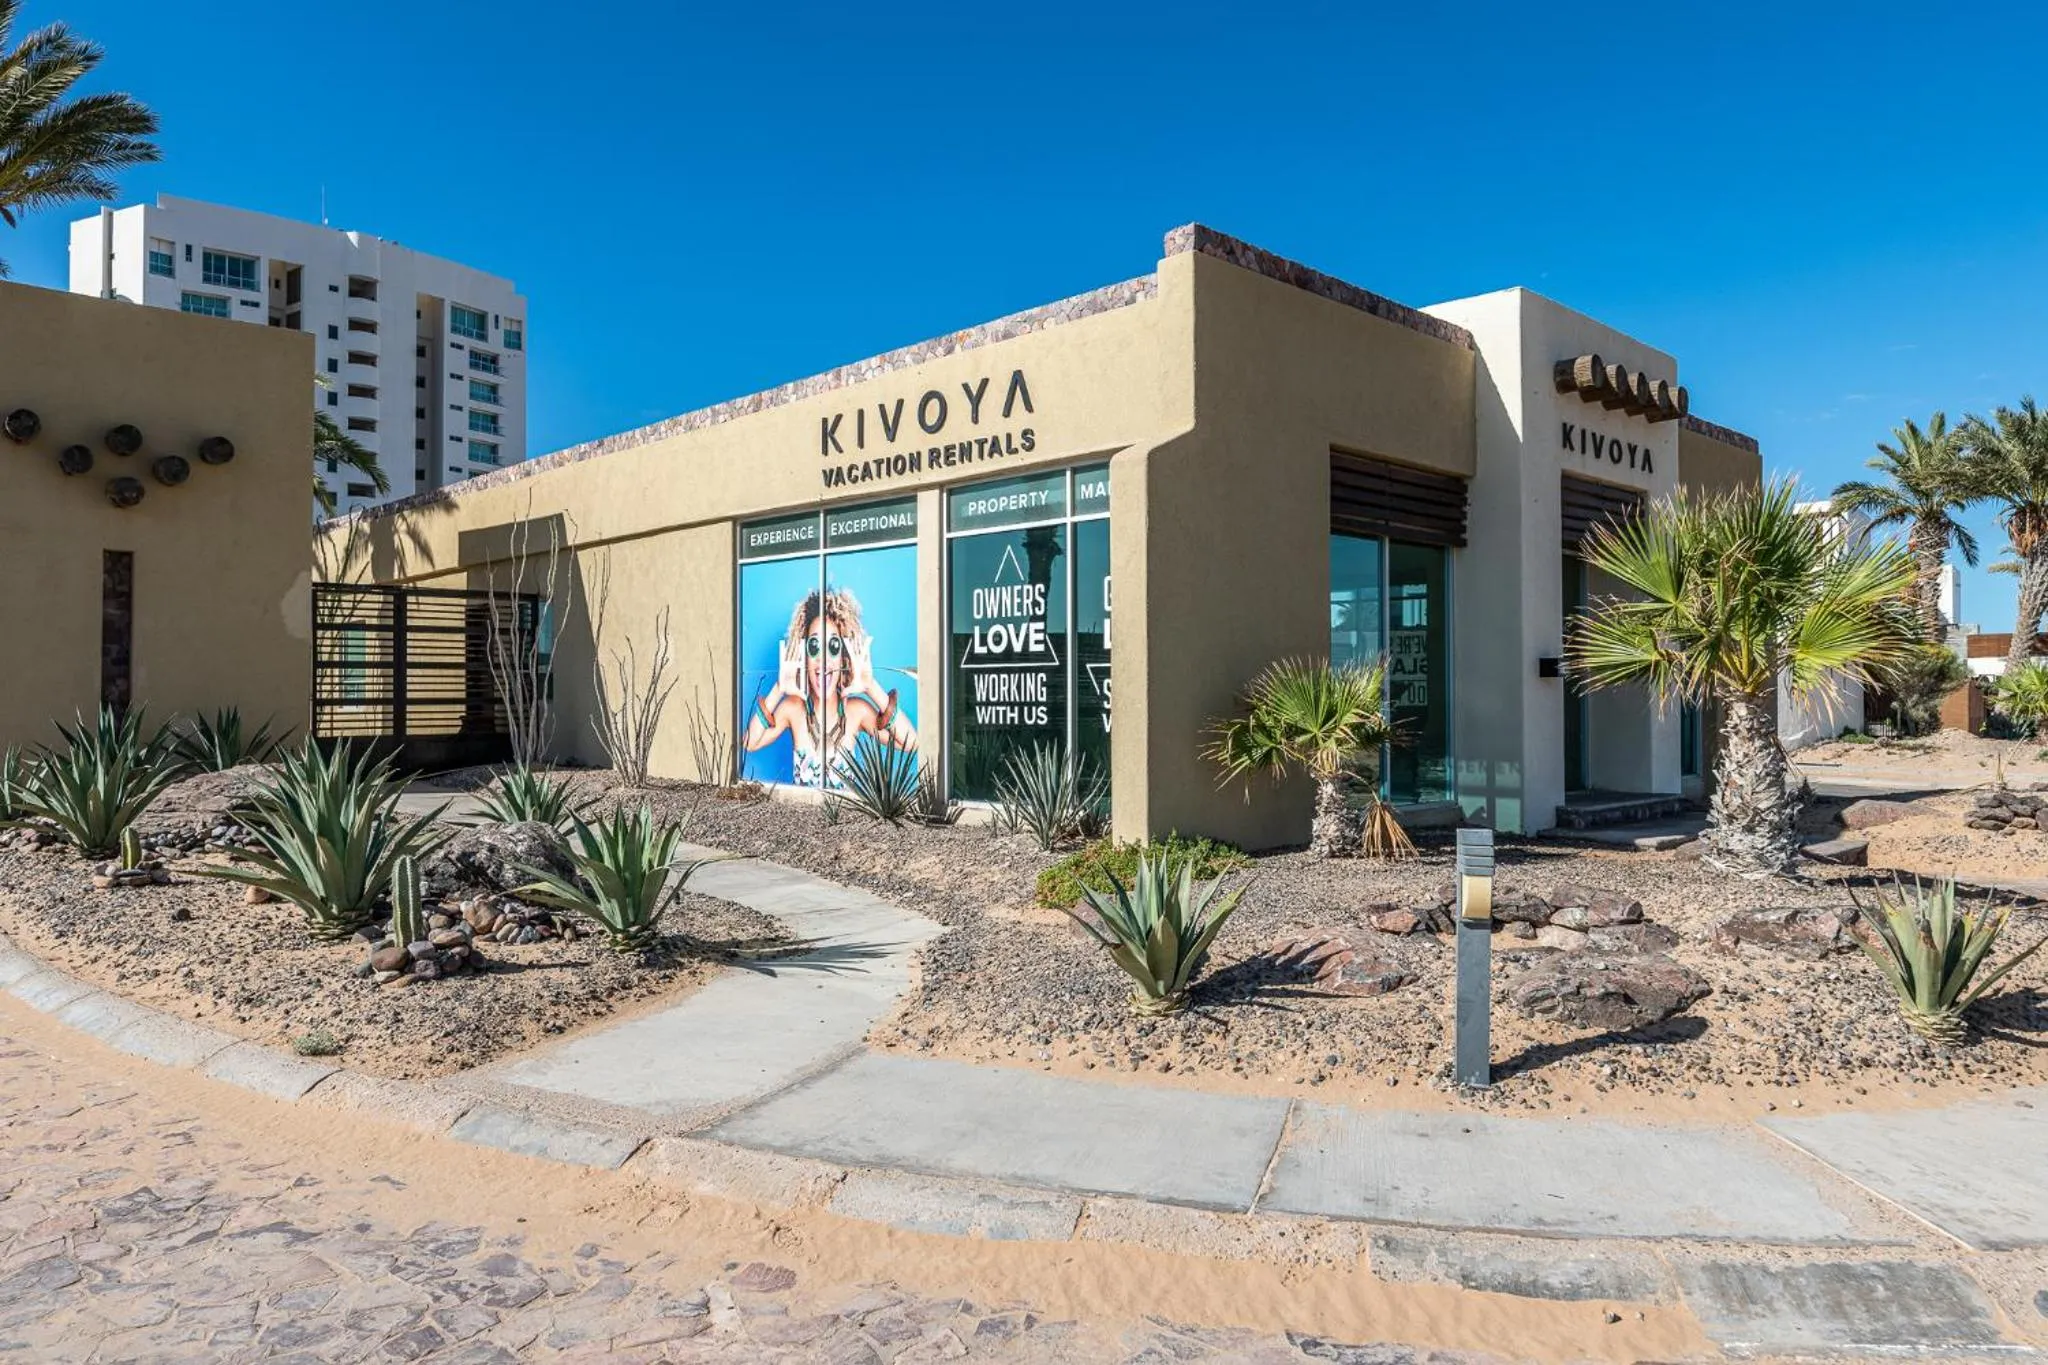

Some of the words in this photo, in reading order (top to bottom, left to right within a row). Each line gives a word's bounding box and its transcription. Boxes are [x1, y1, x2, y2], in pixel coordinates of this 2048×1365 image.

[821, 369, 1034, 456] KIVOYA
[822, 451, 922, 488] VACATION
[928, 428, 1036, 470] RENTALS
[1562, 422, 1653, 474] KIVOYA
[968, 490, 1049, 516] PROPERTY
[1080, 480, 1111, 500] MA
[750, 525, 814, 547] EXPERIENCE
[831, 512, 913, 536] EXCEPTIONAL
[973, 583, 1046, 619] OWNERS
[974, 621, 1045, 654] LOVE
[974, 672, 1047, 703] WORKING
[976, 705, 1019, 725] WITH
[1023, 705, 1048, 725] US
